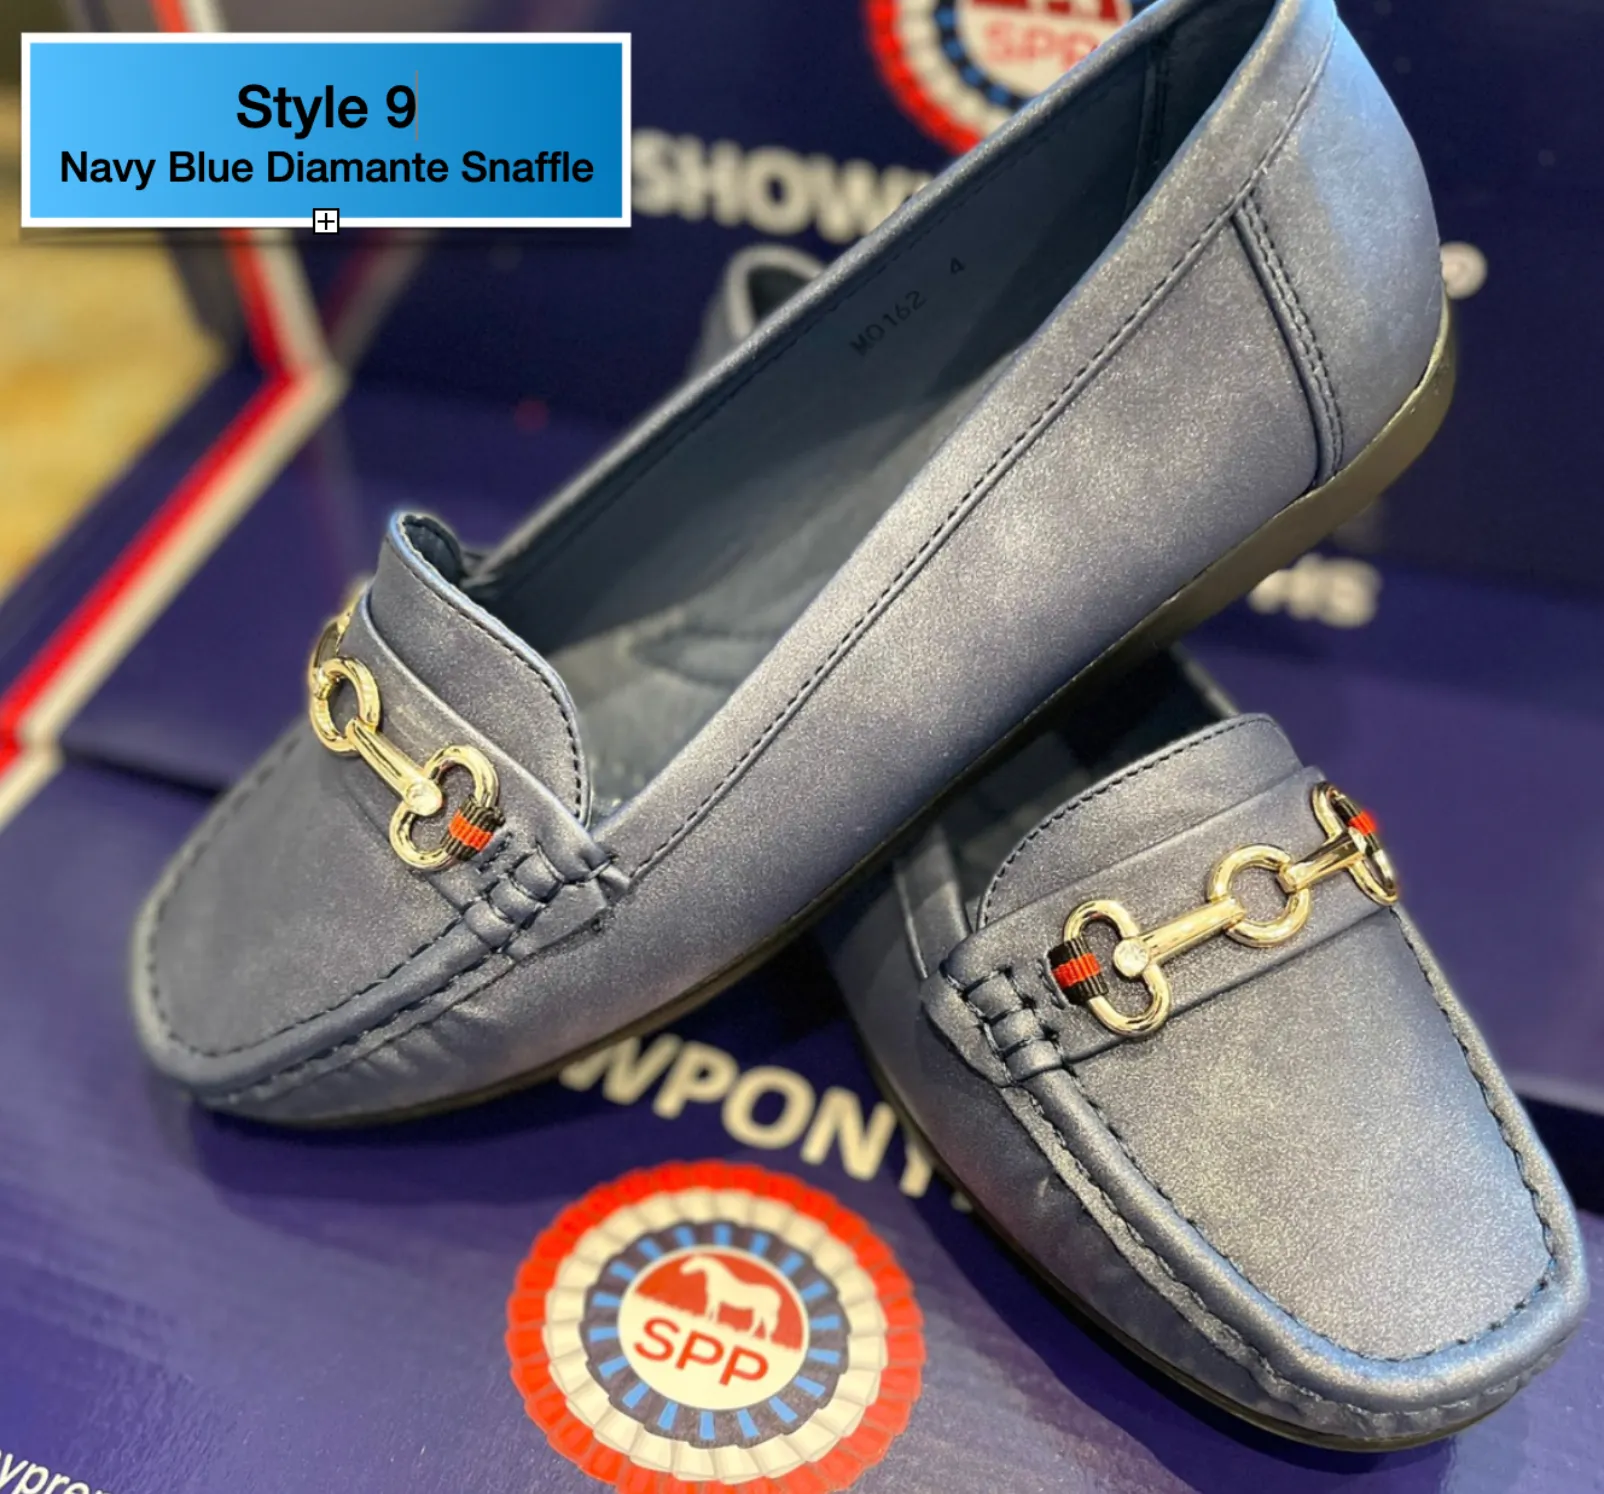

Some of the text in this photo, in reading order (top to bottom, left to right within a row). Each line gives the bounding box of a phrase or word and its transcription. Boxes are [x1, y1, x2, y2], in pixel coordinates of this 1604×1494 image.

[631, 128, 932, 243] SHOW
[950, 257, 966, 275] 4
[634, 1317, 769, 1386] SPP
